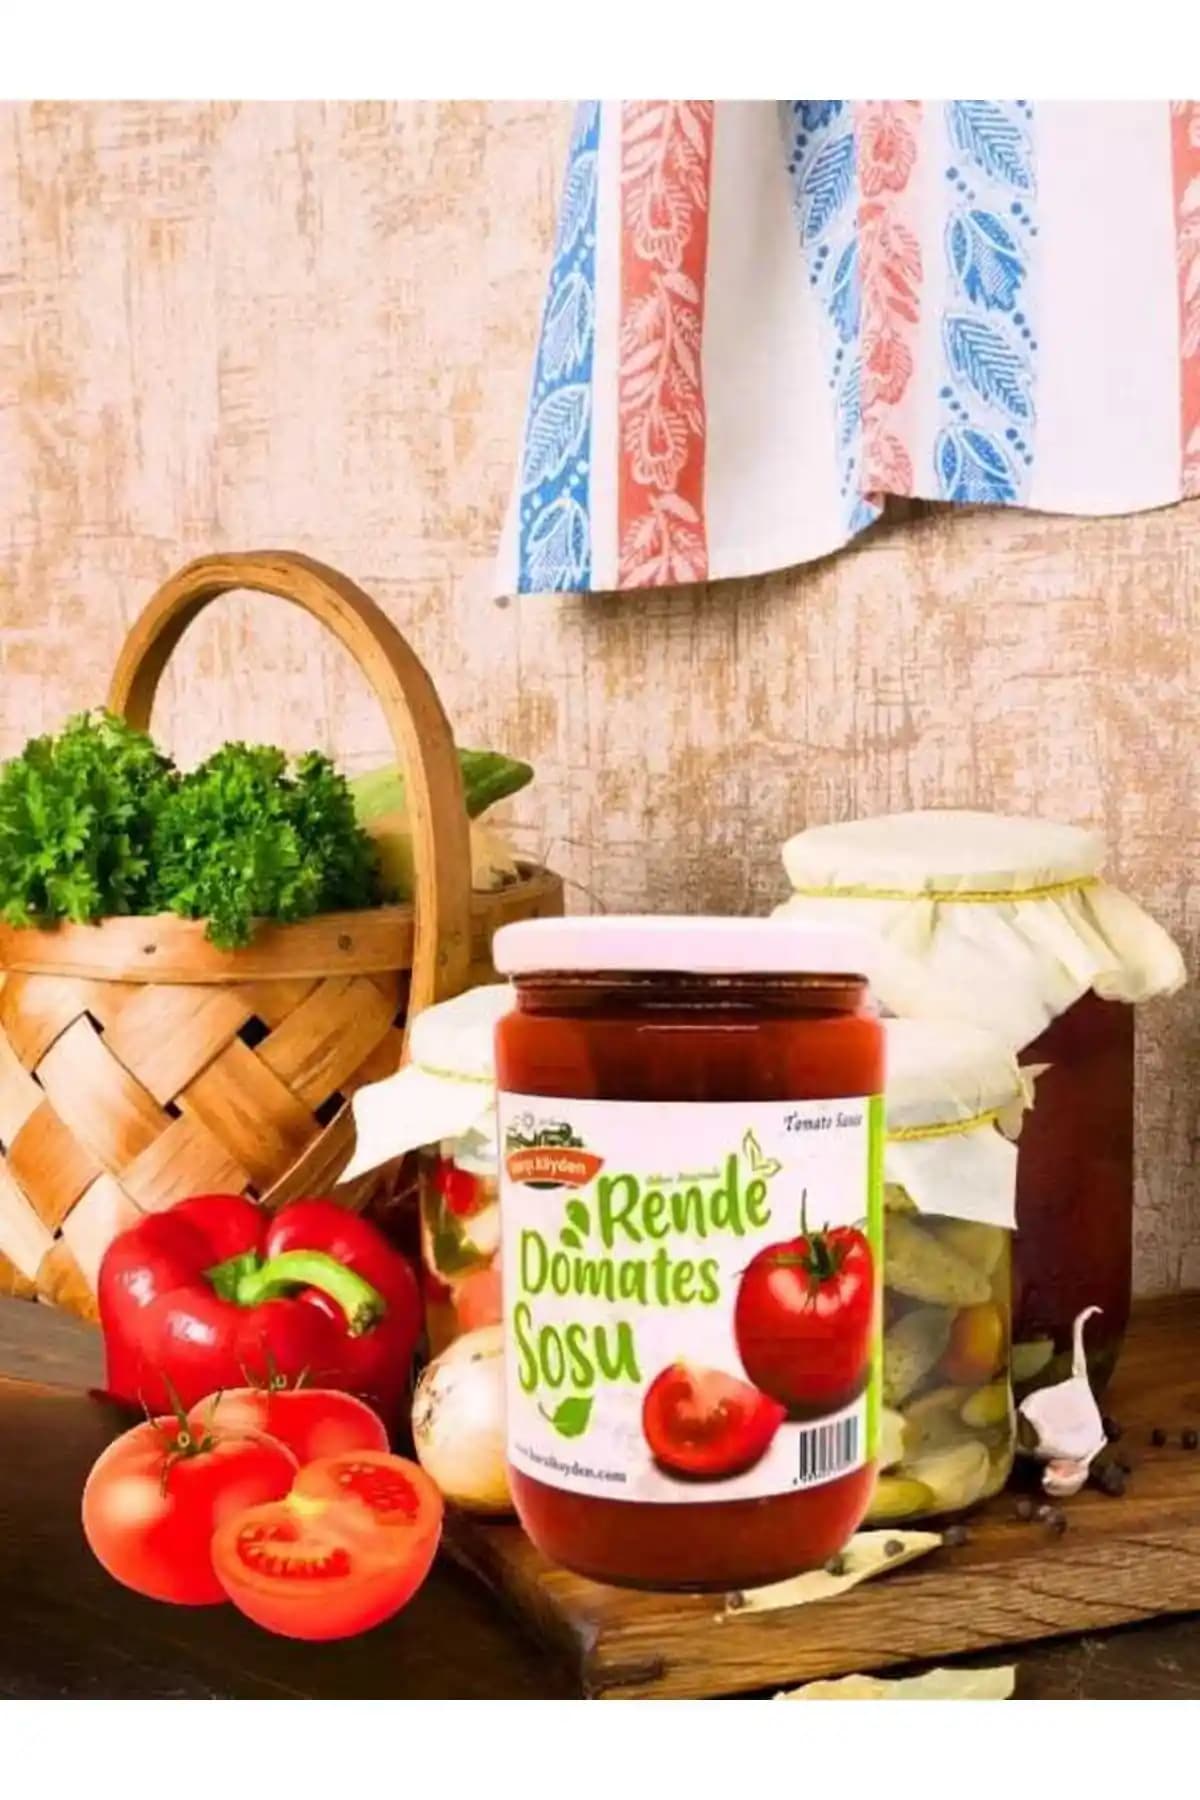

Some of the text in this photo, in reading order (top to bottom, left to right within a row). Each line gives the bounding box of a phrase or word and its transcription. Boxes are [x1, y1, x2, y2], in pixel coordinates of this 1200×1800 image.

[783, 1111, 832, 1131] Tomato
[598, 1153, 772, 1249] Rende
[520, 1229, 720, 1306] Domates
[513, 1302, 641, 1394] Sosu
